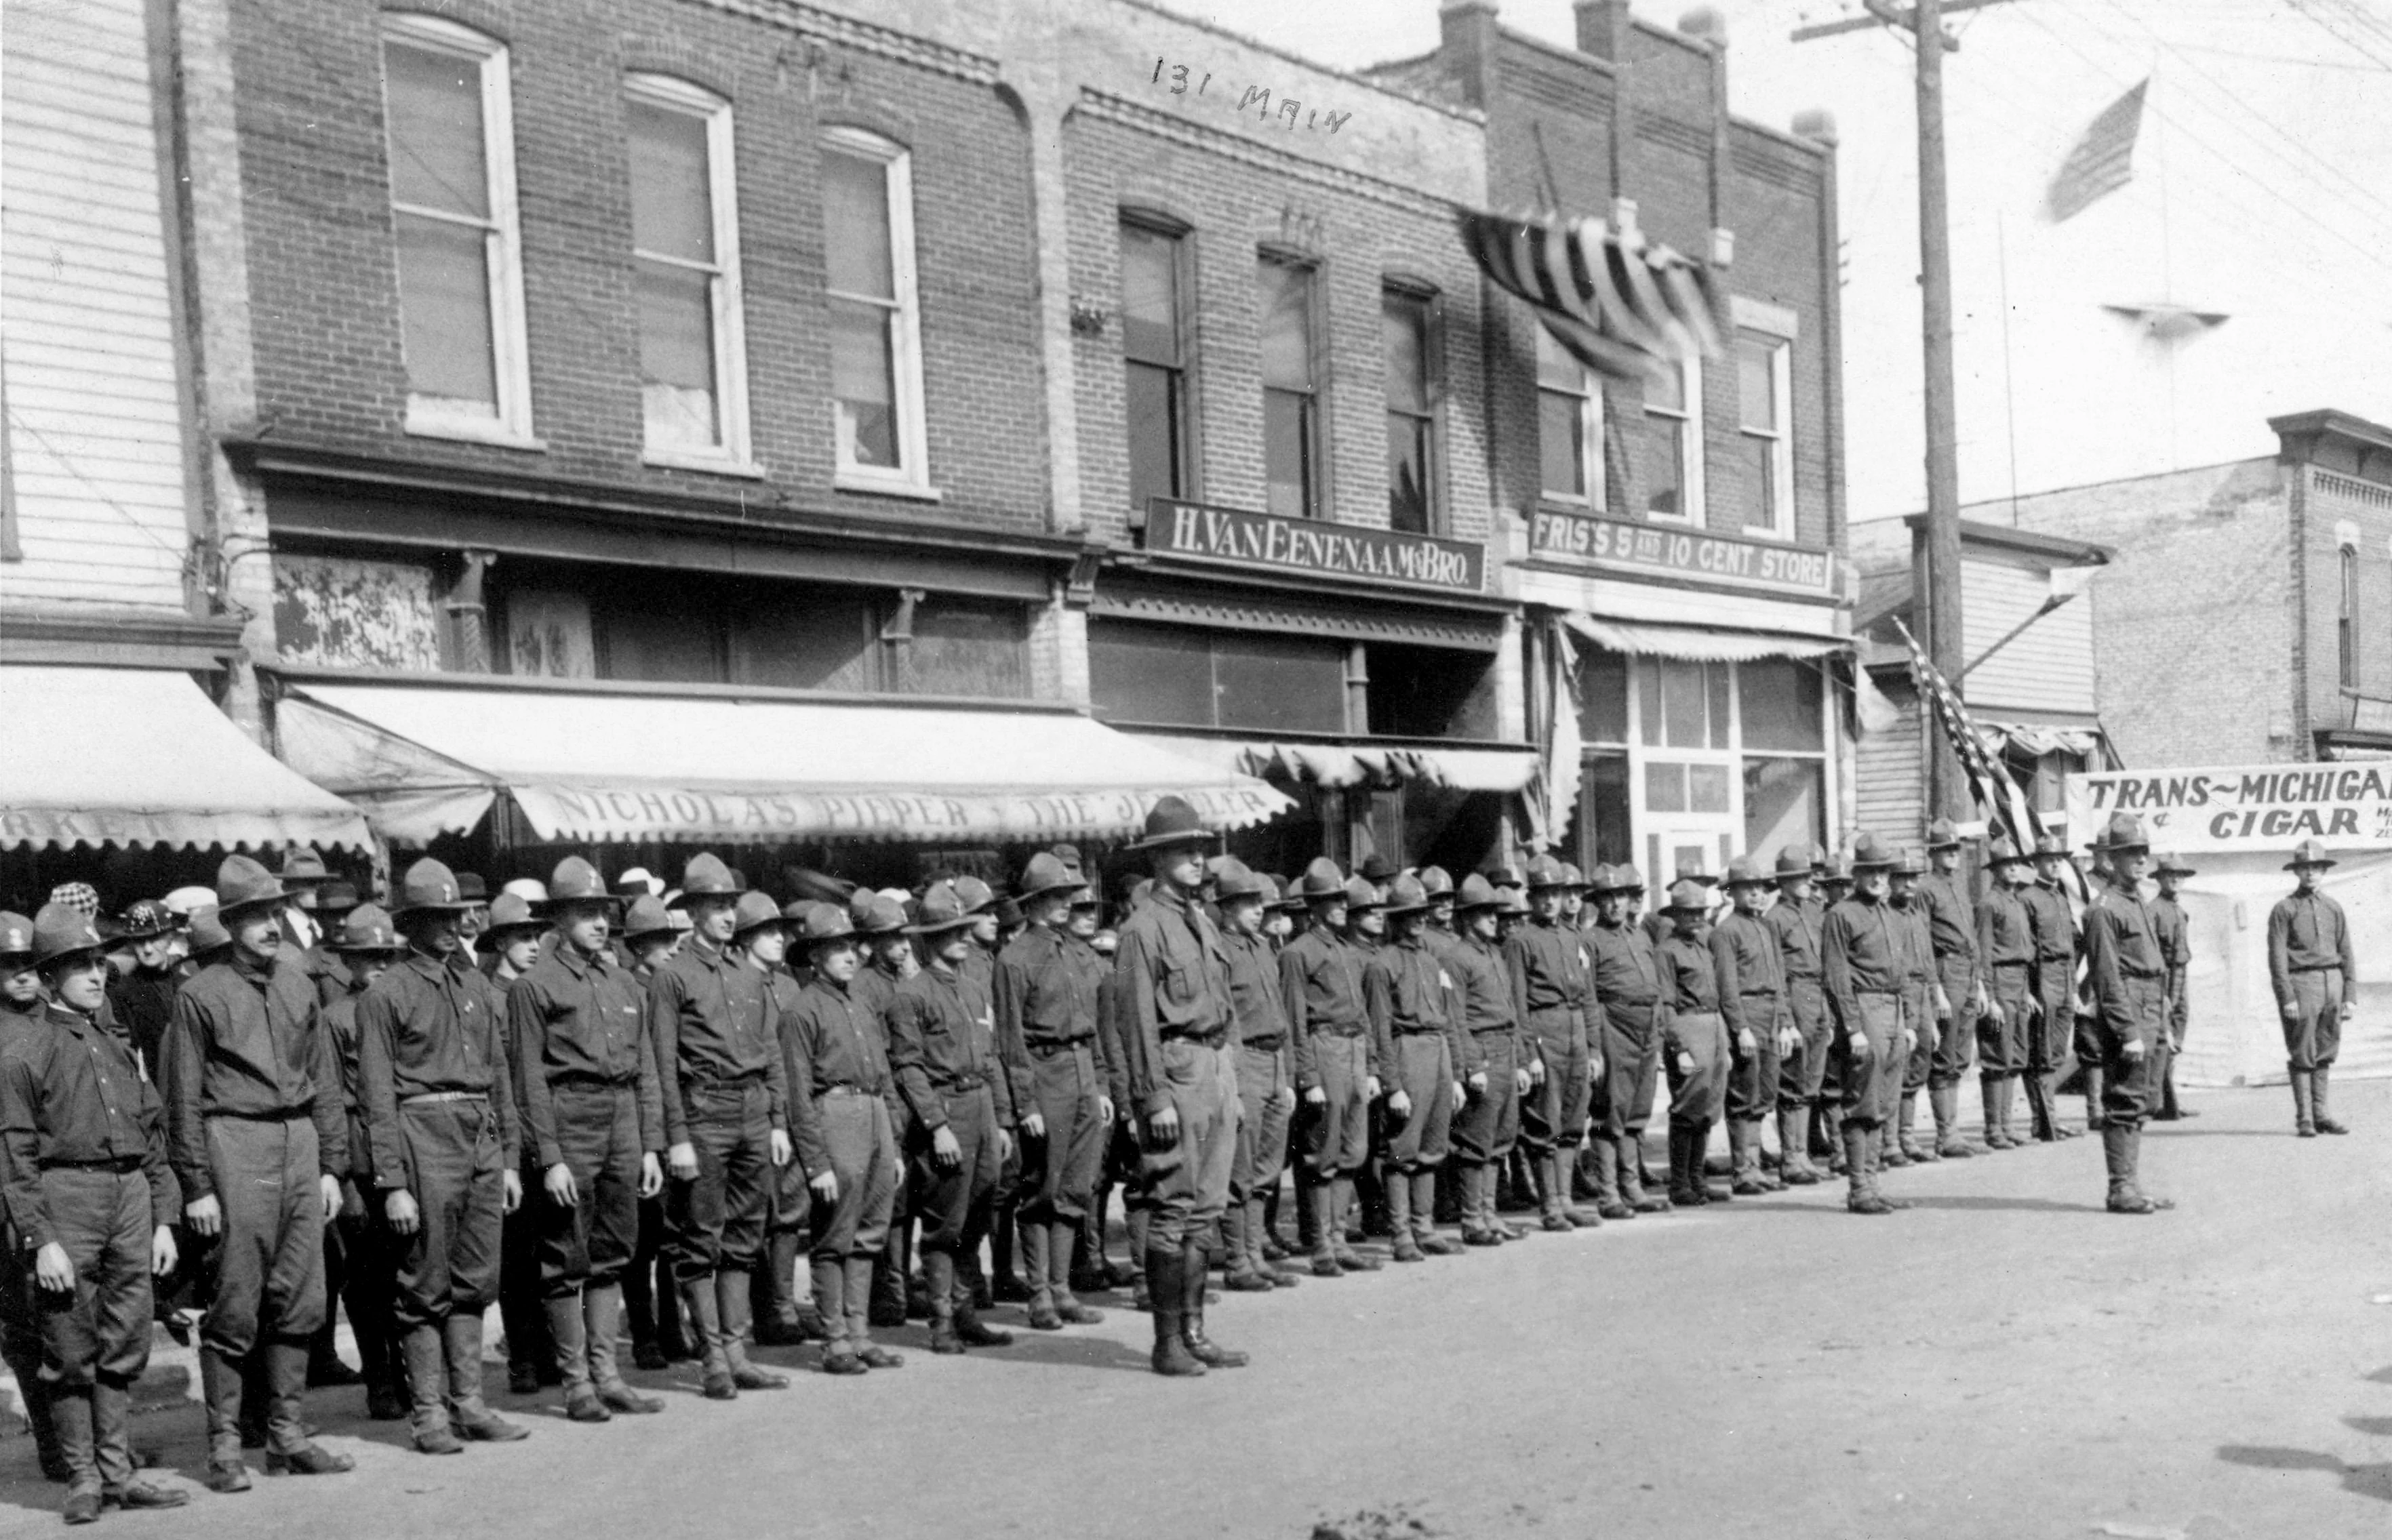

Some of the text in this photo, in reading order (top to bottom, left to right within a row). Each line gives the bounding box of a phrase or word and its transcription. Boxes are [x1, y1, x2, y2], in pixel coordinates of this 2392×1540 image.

[1616, 527, 1633, 557] 5
[1635, 534, 1662, 558] AND
[1667, 535, 1692, 566] 10
[1698, 540, 1754, 575] CENT
[1761, 550, 1824, 586] STORE
[553, 791, 799, 826] NICHOLAS
[1026, 796, 1098, 826] THE
[2209, 807, 2361, 840] CIGAR
